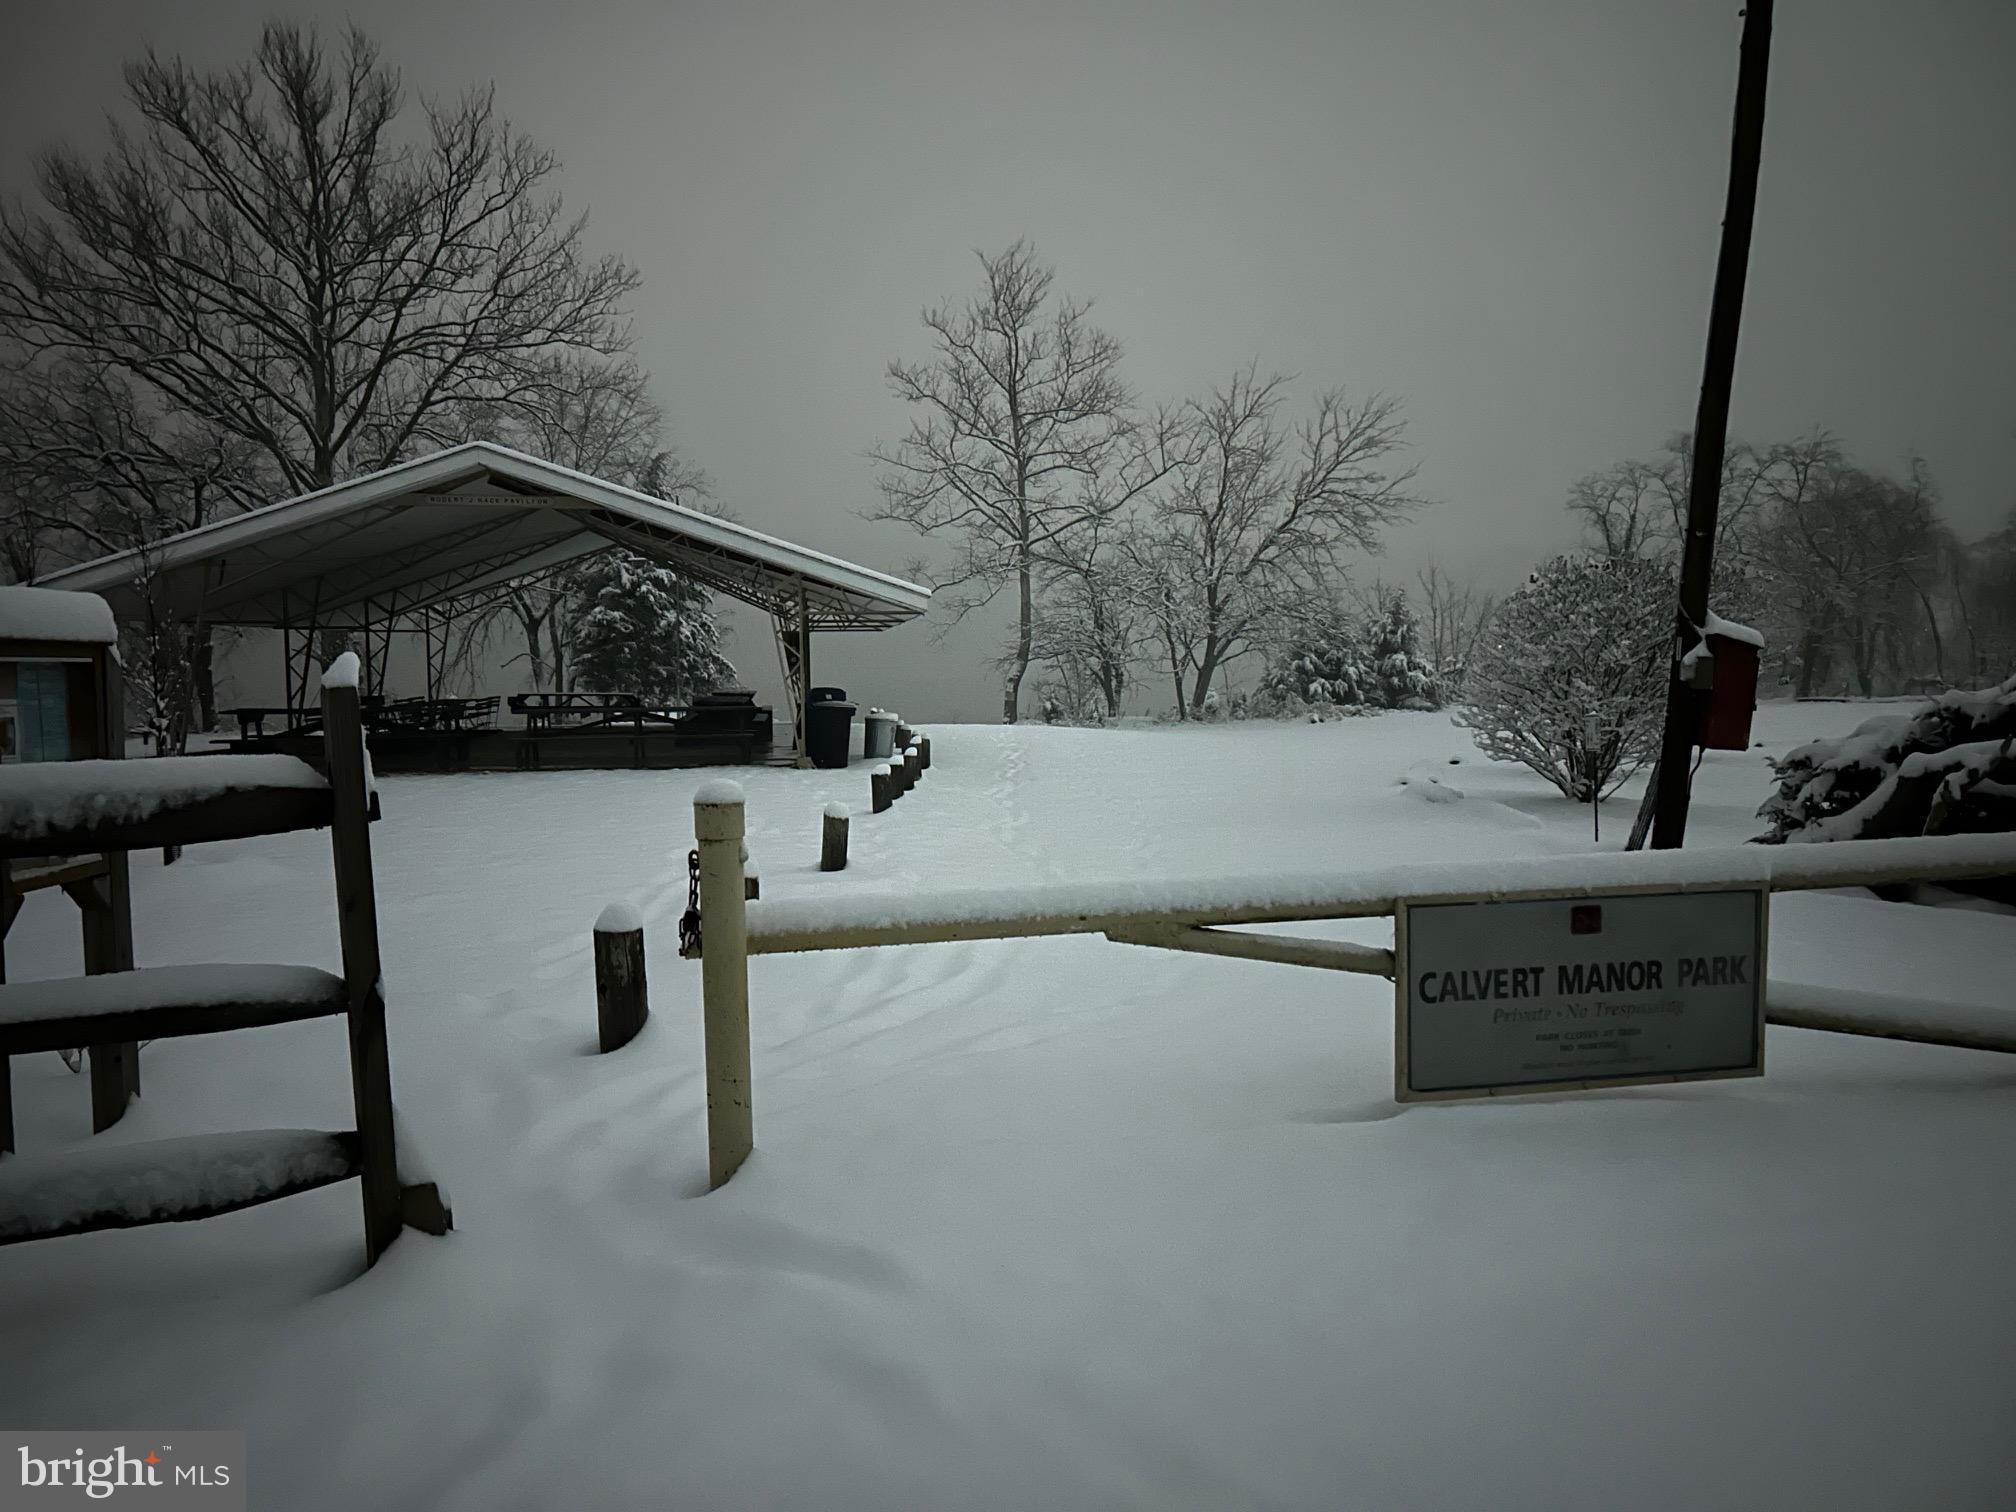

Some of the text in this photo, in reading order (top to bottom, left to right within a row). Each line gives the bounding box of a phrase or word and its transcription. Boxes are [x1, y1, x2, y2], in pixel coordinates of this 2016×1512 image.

[1418, 955, 1747, 1004] CALVERT MANOR PARK
[1493, 999, 1684, 1024] Private No Trespassing
